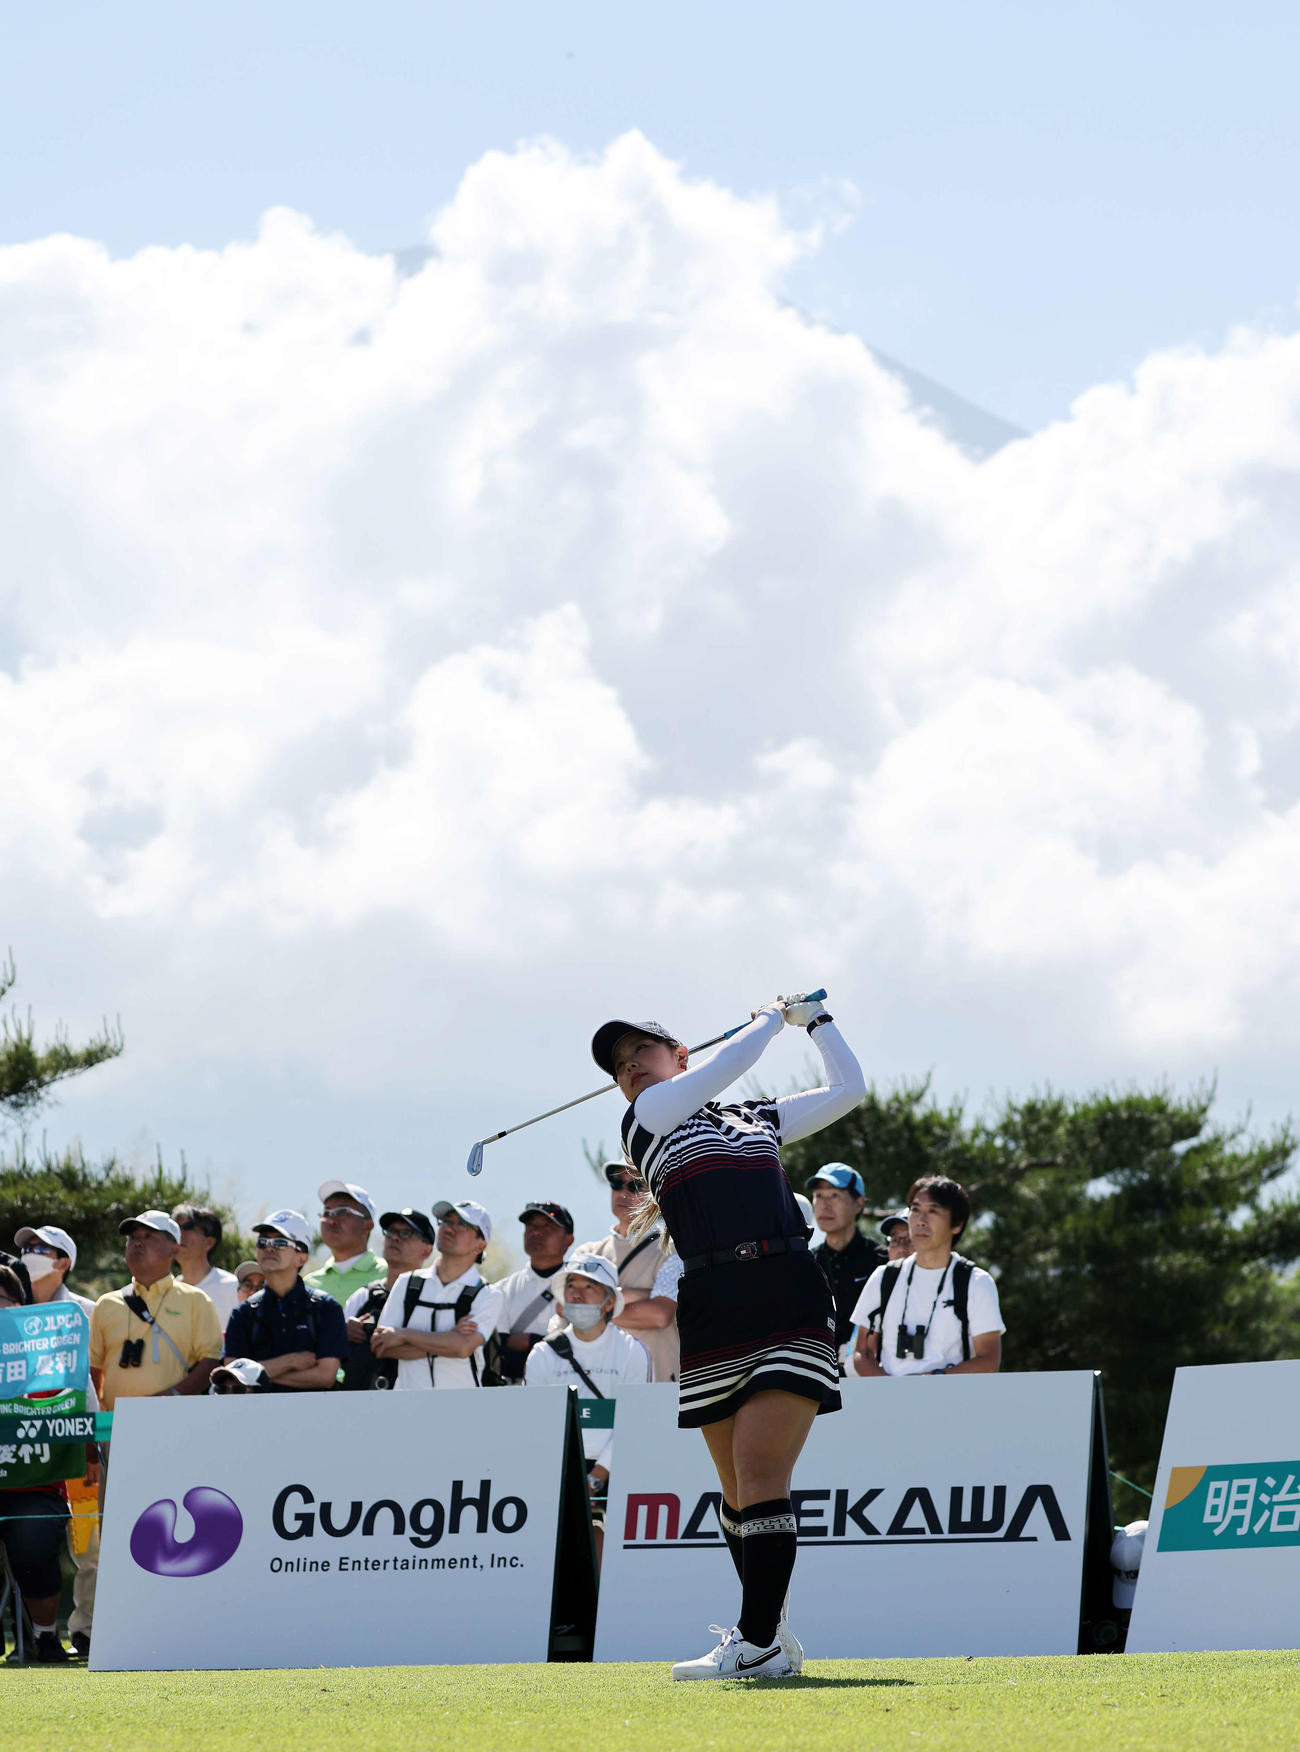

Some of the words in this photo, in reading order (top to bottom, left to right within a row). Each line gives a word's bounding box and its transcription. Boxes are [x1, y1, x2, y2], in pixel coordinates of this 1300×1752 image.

[43, 1312, 82, 1331] JLPGA
[2, 1336, 49, 1355] BRIGHTER
[0, 1360, 26, 1384] 田
[46, 1416, 94, 1438] YONEX
[272, 1478, 527, 1550] GungHo
[623, 1483, 1070, 1540] MAEKAWA
[270, 1556, 330, 1573] Online
[338, 1552, 484, 1571] Entertainment,
[490, 1553, 525, 1569] Inc.
